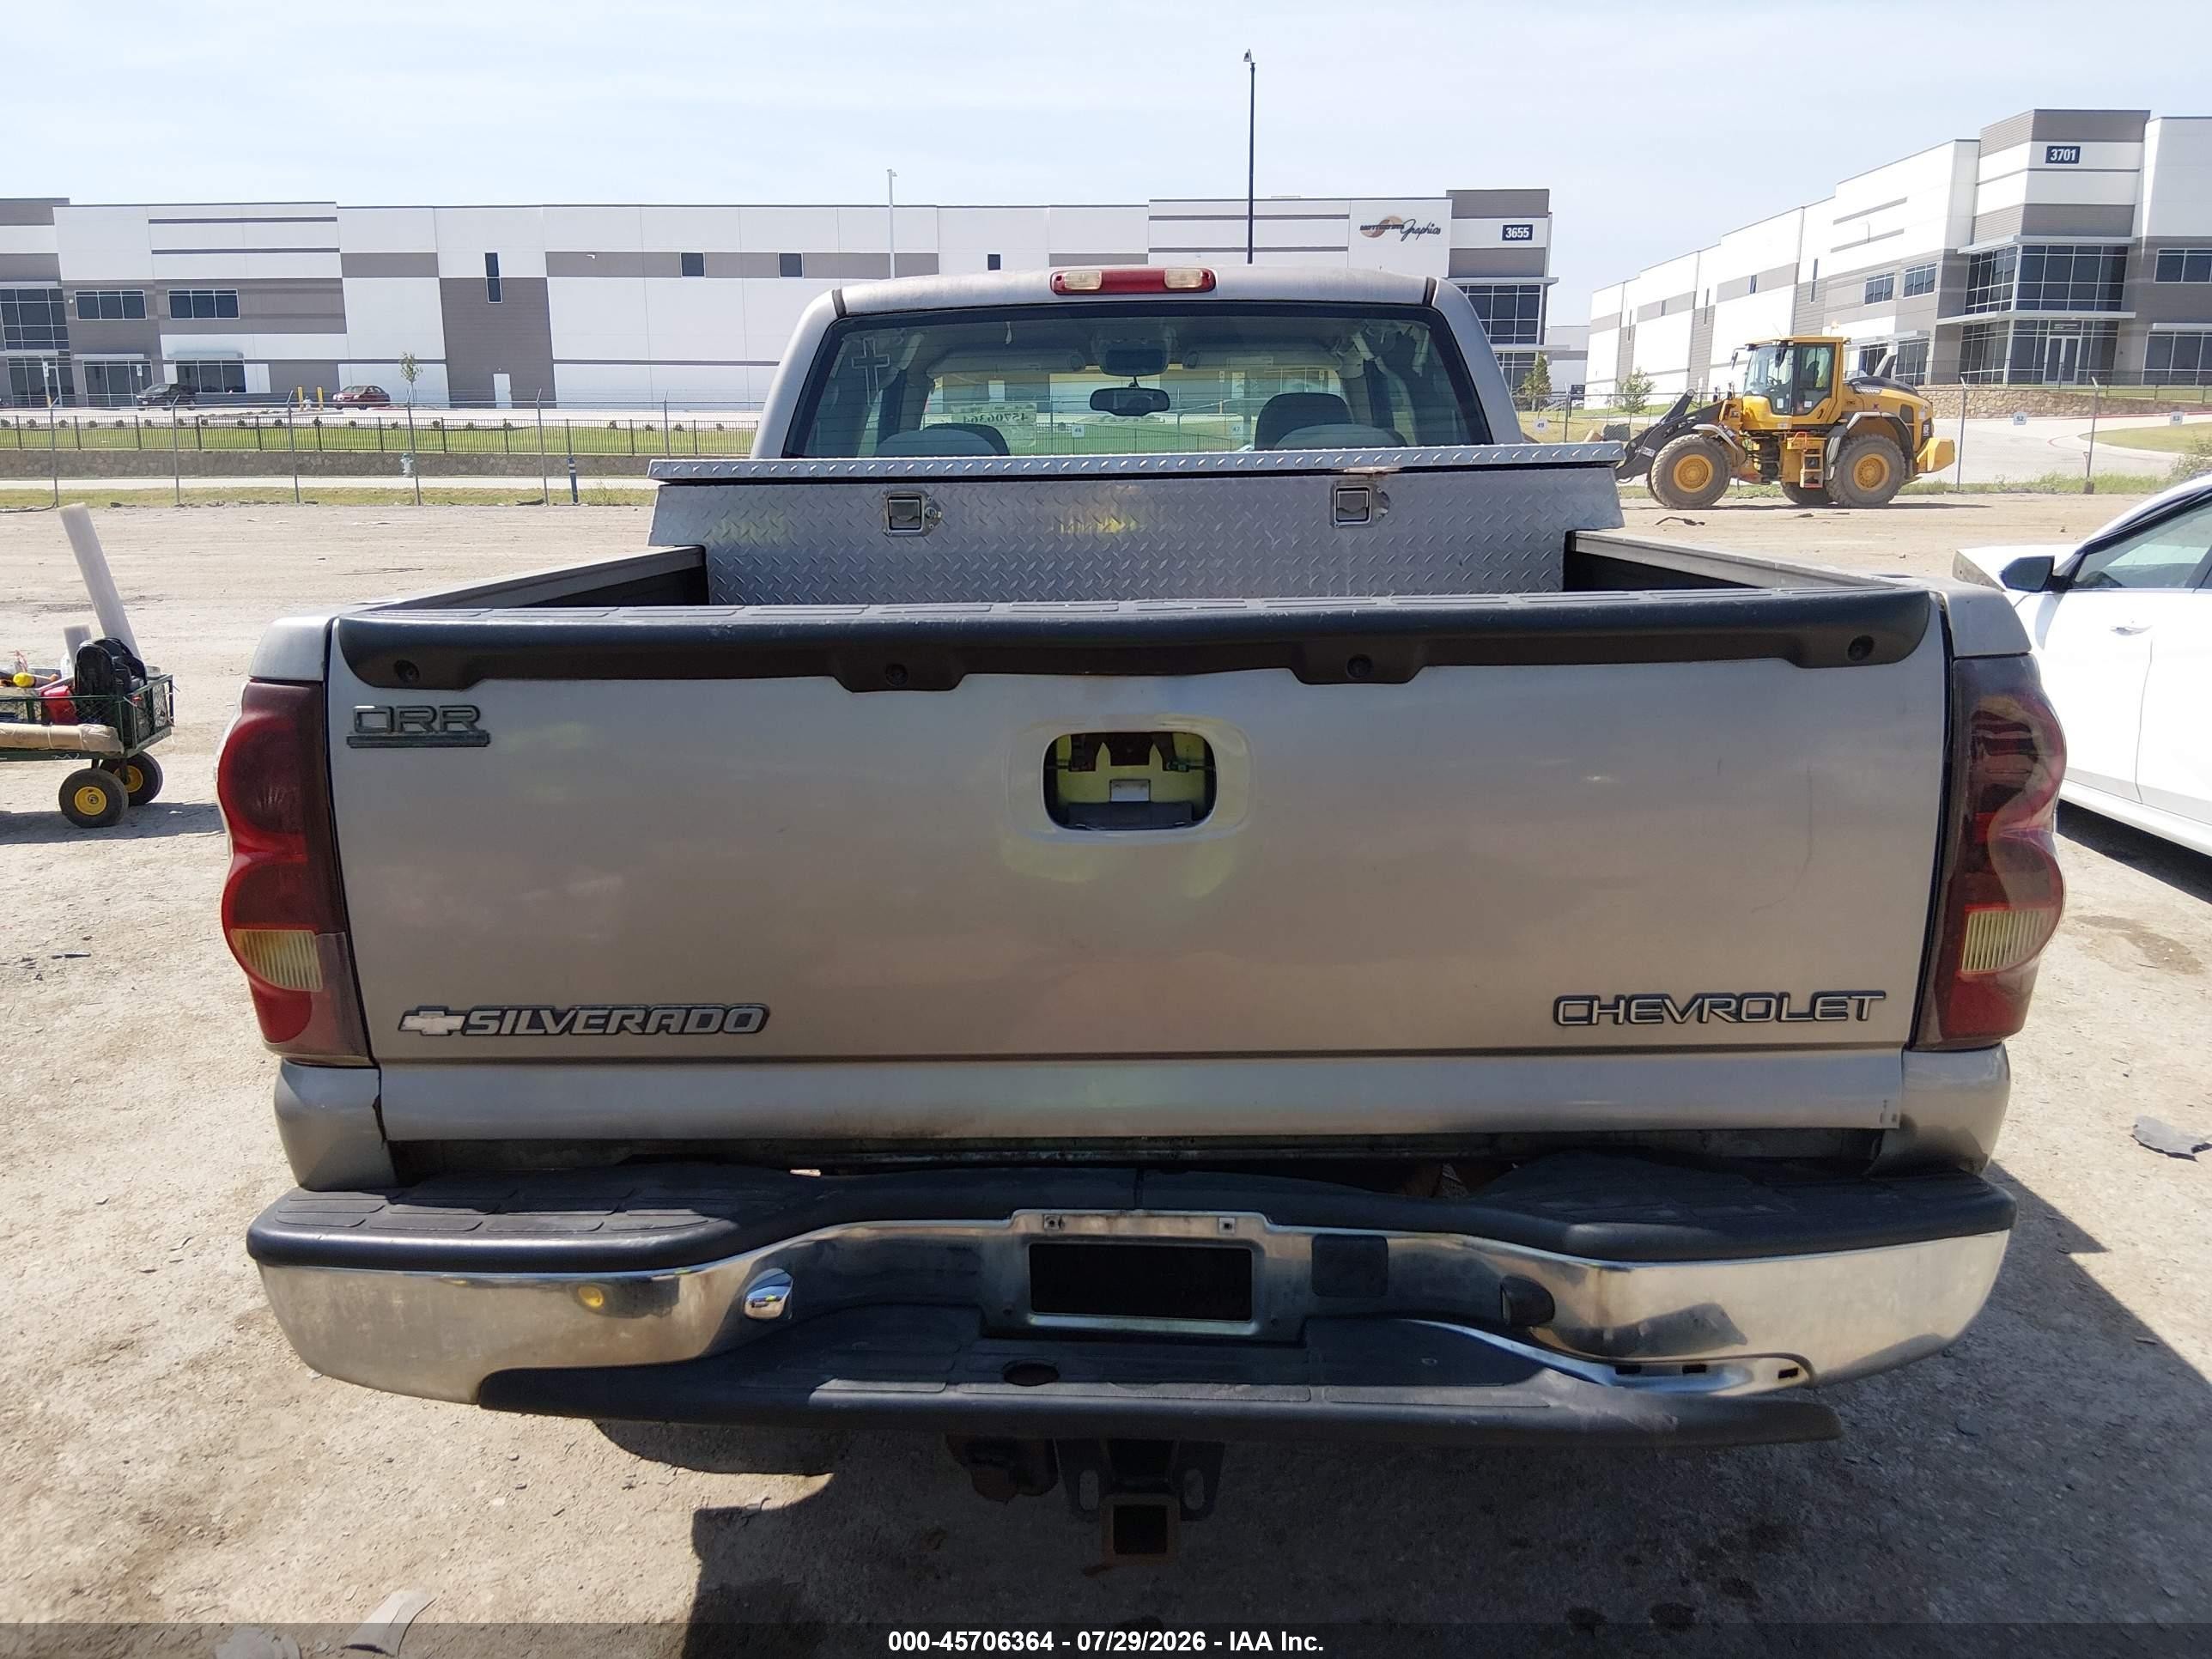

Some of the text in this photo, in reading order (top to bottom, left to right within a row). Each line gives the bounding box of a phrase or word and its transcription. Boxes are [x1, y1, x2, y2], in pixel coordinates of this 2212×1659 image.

[2050, 148, 2076, 161] 3701
[1400, 218, 1442, 242] Graphics
[1504, 226, 1530, 240] 3655
[353, 704, 483, 733] ORR
[463, 1004, 769, 1036] SILVERADO
[1553, 990, 1887, 1026] CHEVROLET
